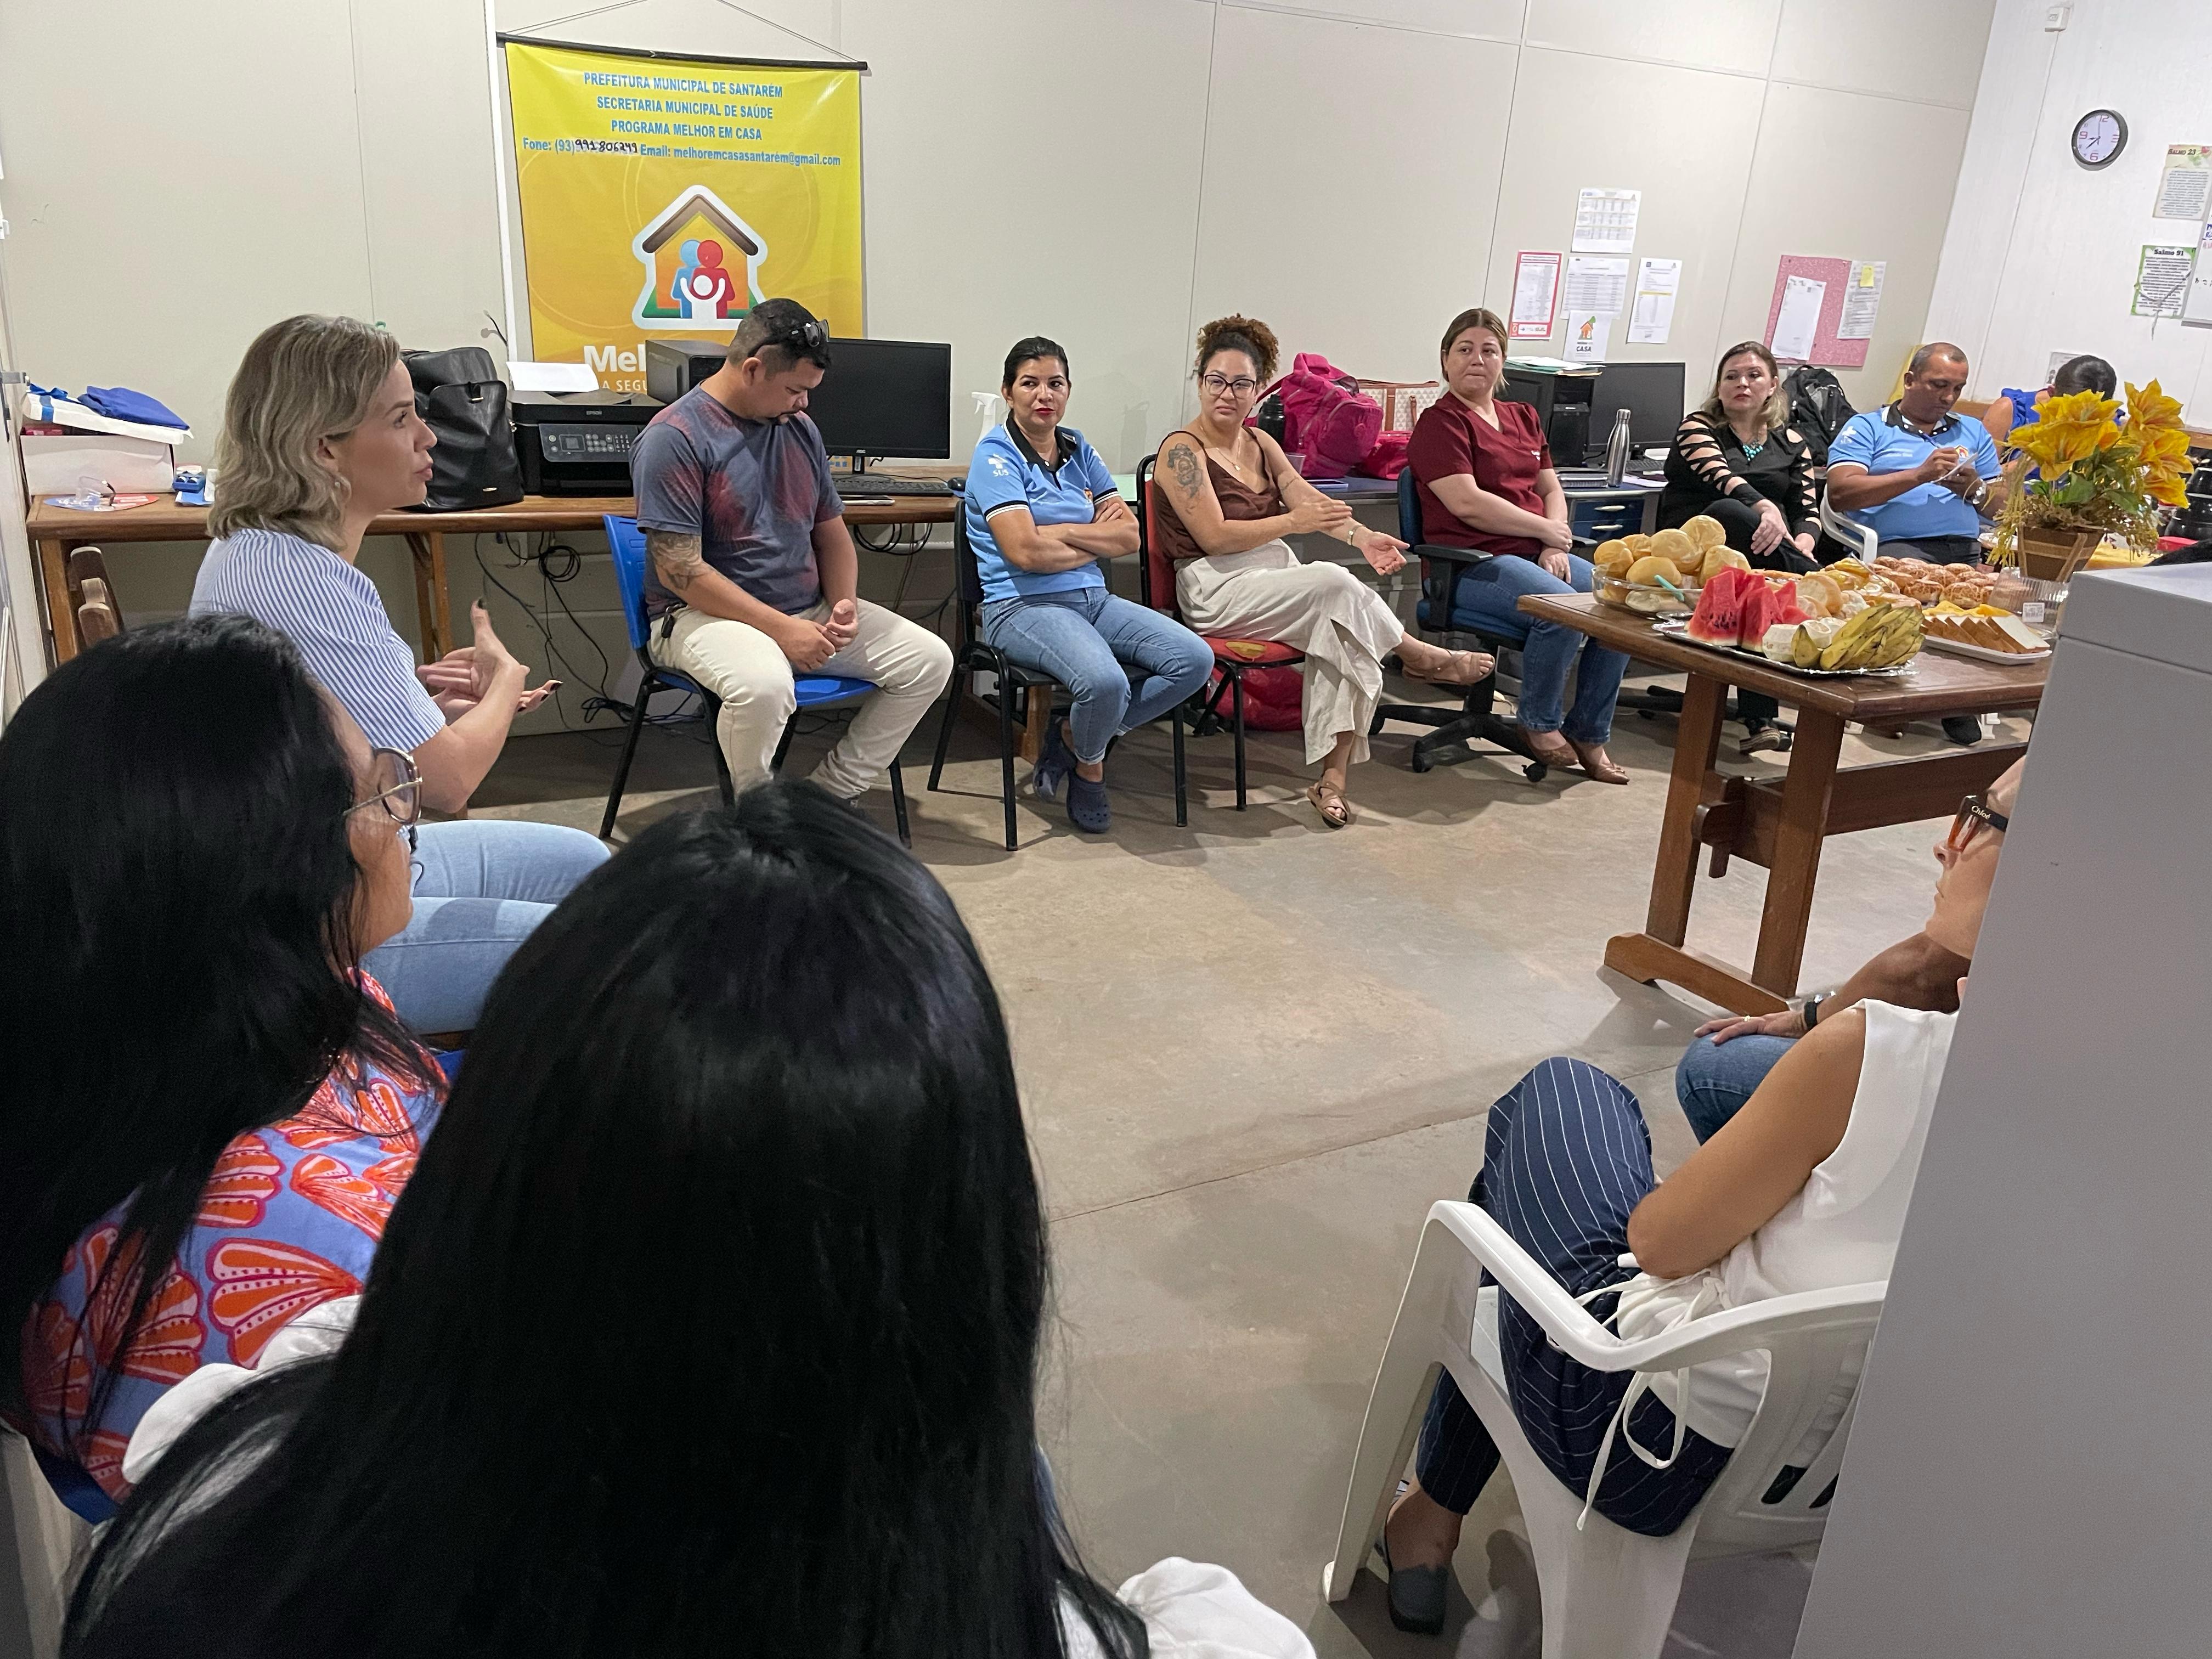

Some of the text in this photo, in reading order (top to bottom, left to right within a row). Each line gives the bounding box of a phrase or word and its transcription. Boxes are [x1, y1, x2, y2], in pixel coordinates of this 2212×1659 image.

[584, 72, 783, 98] PREFEITURA MUNICIPAL DE SANTARÉM
[597, 96, 774, 119] SECRETARIA MUNICIPAL DE SAÚDE
[611, 120, 763, 140] PROGRAMA MELHOR EM CASA
[523, 137, 551, 151] Fone:
[640, 144, 671, 157] Email:
[674, 146, 840, 167] melhoremcasasantarém@gmail.com
